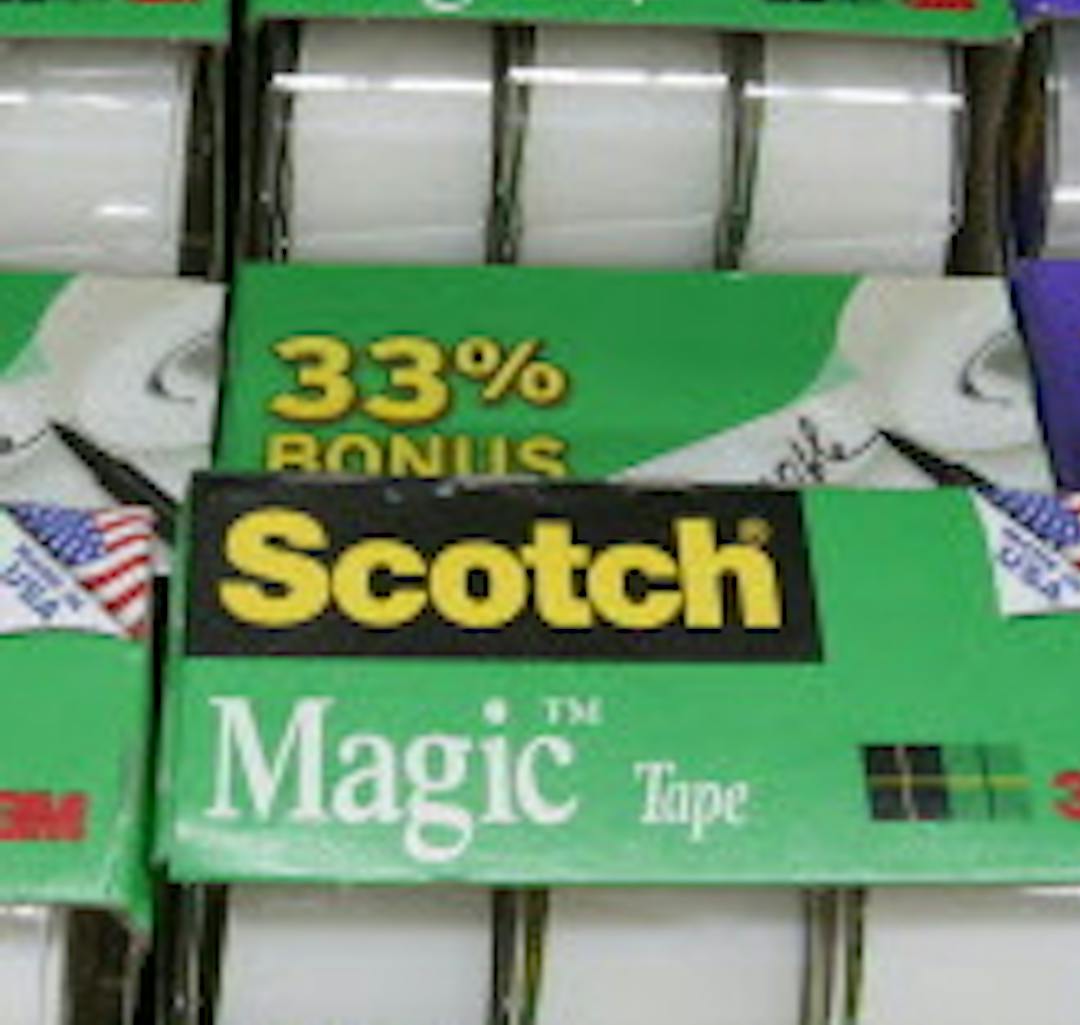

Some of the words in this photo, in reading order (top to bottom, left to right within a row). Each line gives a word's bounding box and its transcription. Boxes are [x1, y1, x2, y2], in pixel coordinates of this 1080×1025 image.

[268, 336, 567, 425] 33%
[217, 509, 779, 628] Scotch
[634, 761, 749, 843] Tape
